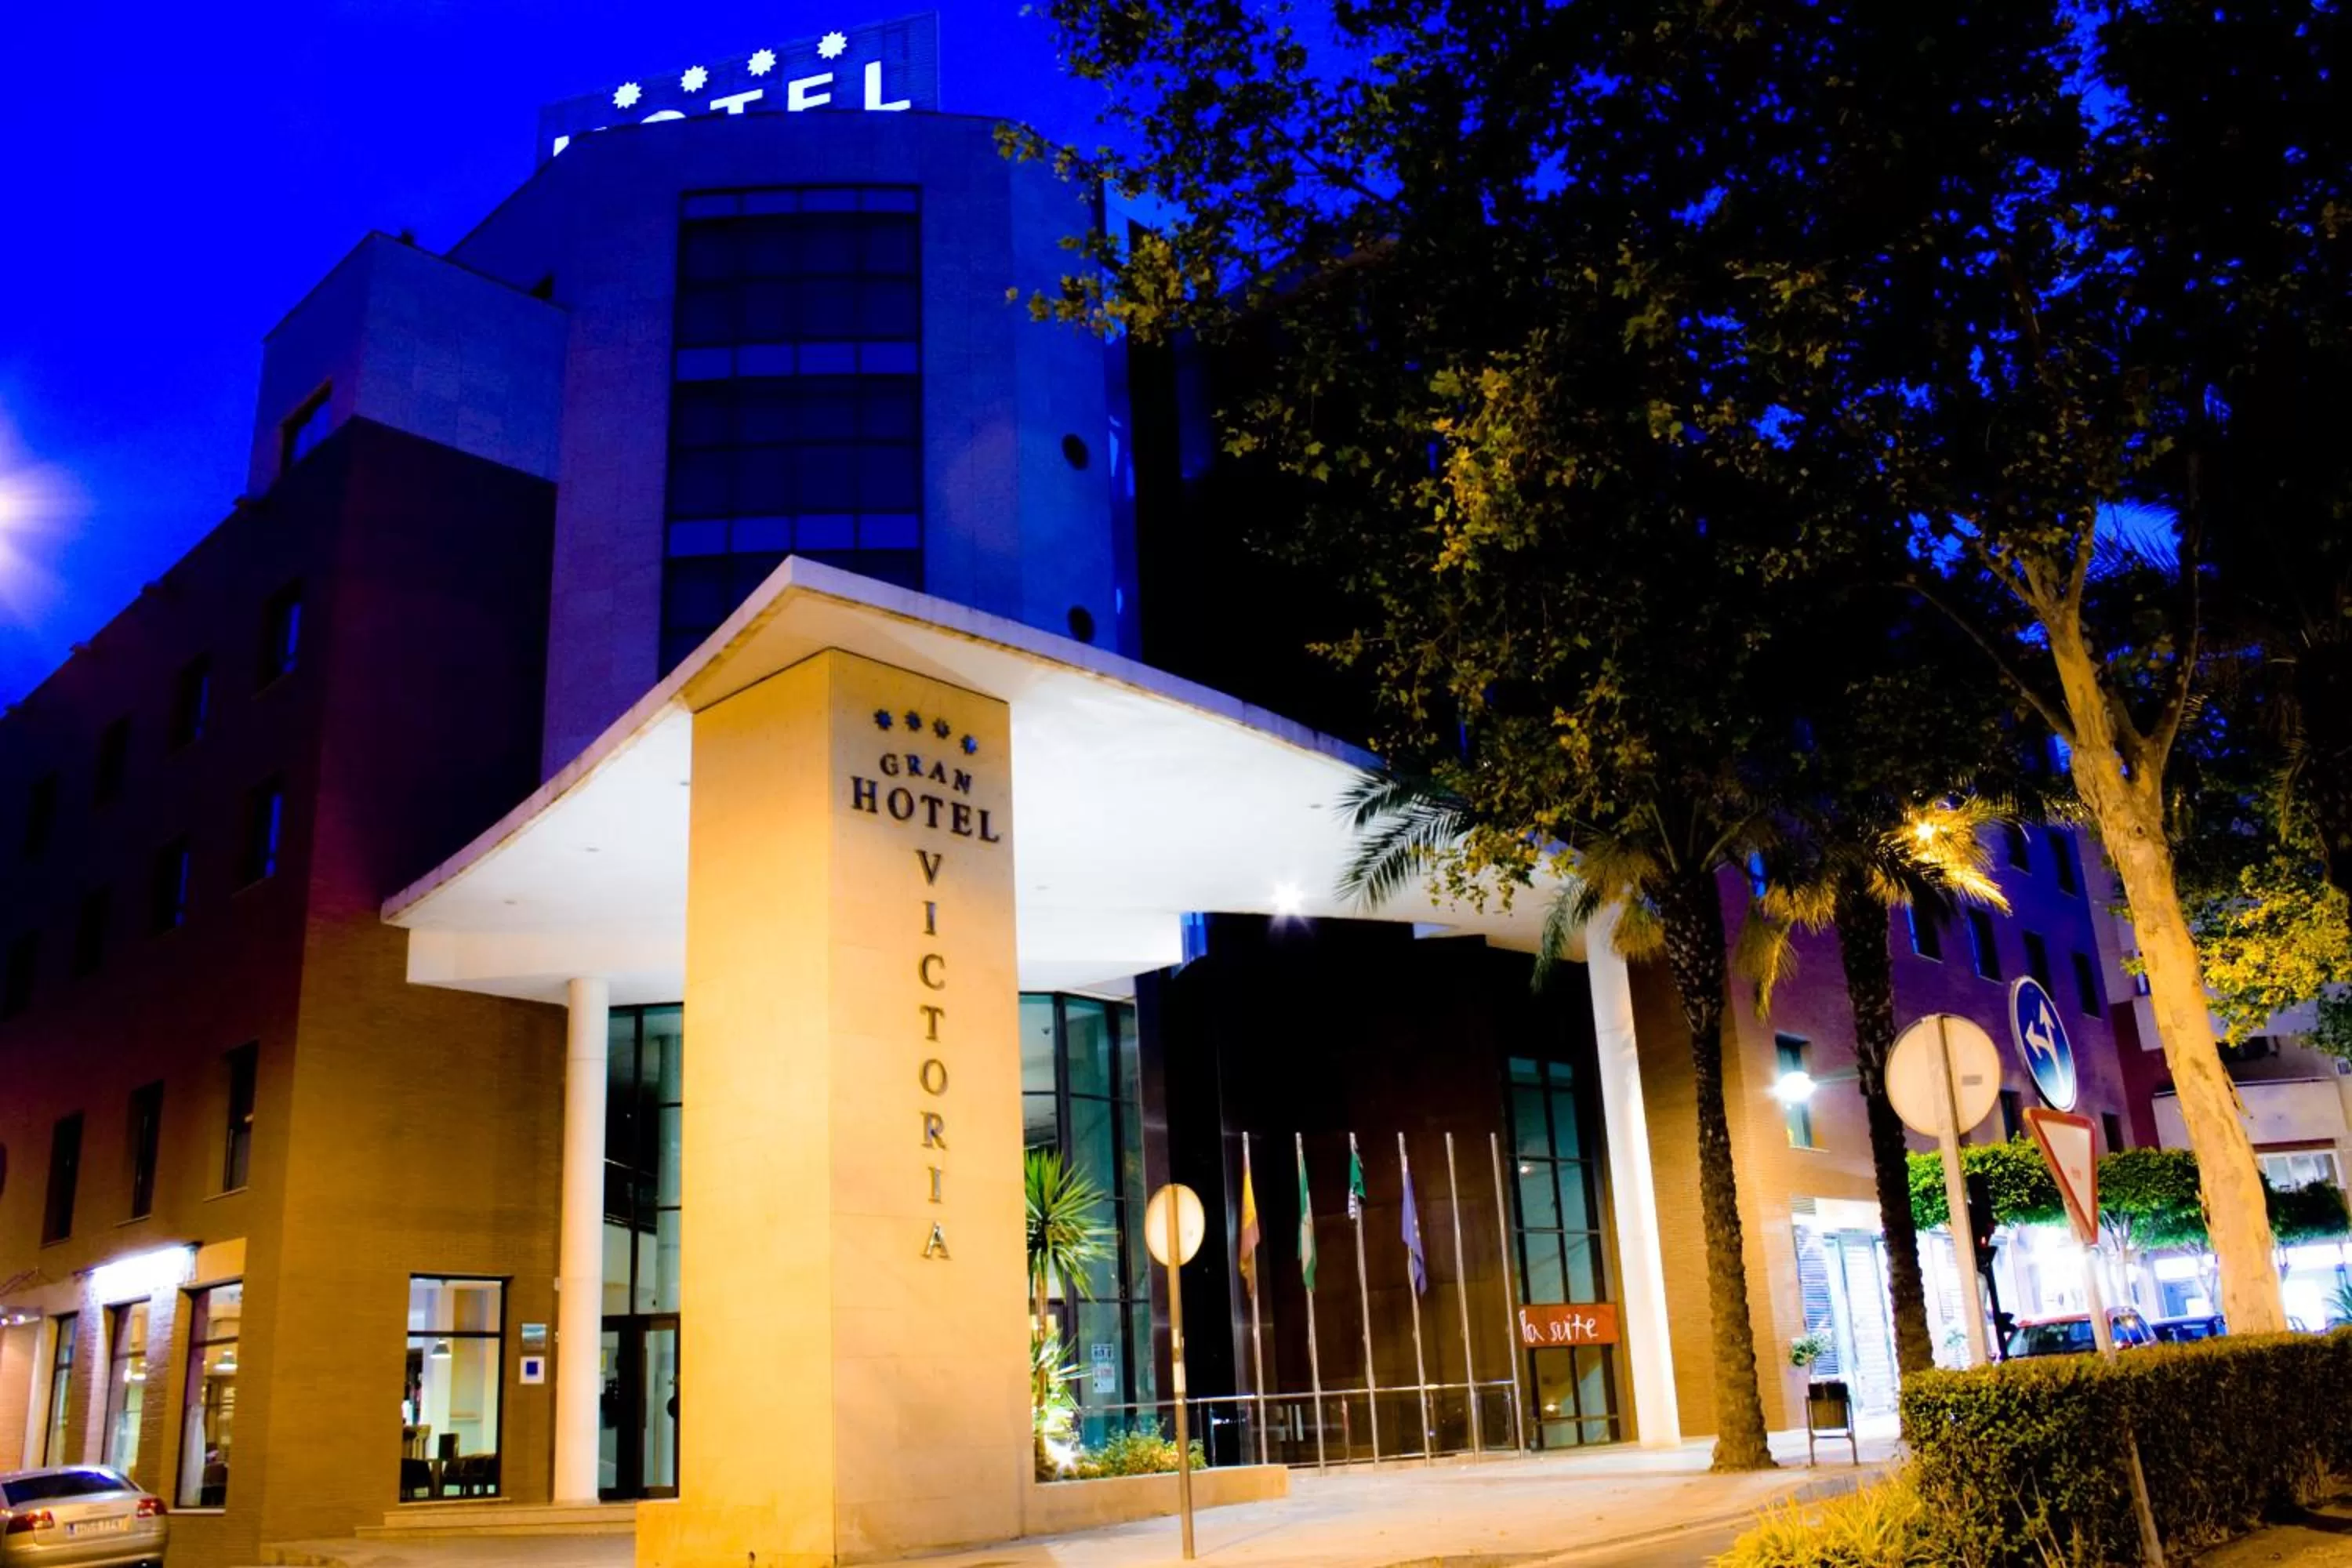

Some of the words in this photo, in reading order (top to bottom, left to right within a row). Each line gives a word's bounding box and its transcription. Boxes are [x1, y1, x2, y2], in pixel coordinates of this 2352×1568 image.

[554, 60, 911, 156] TEL
[880, 753, 972, 794] GRAN
[851, 775, 1000, 843] HOTEL
[916, 849, 951, 1261] VICTORIA
[1519, 1309, 1544, 1343] la
[1550, 1313, 1599, 1342] suite
